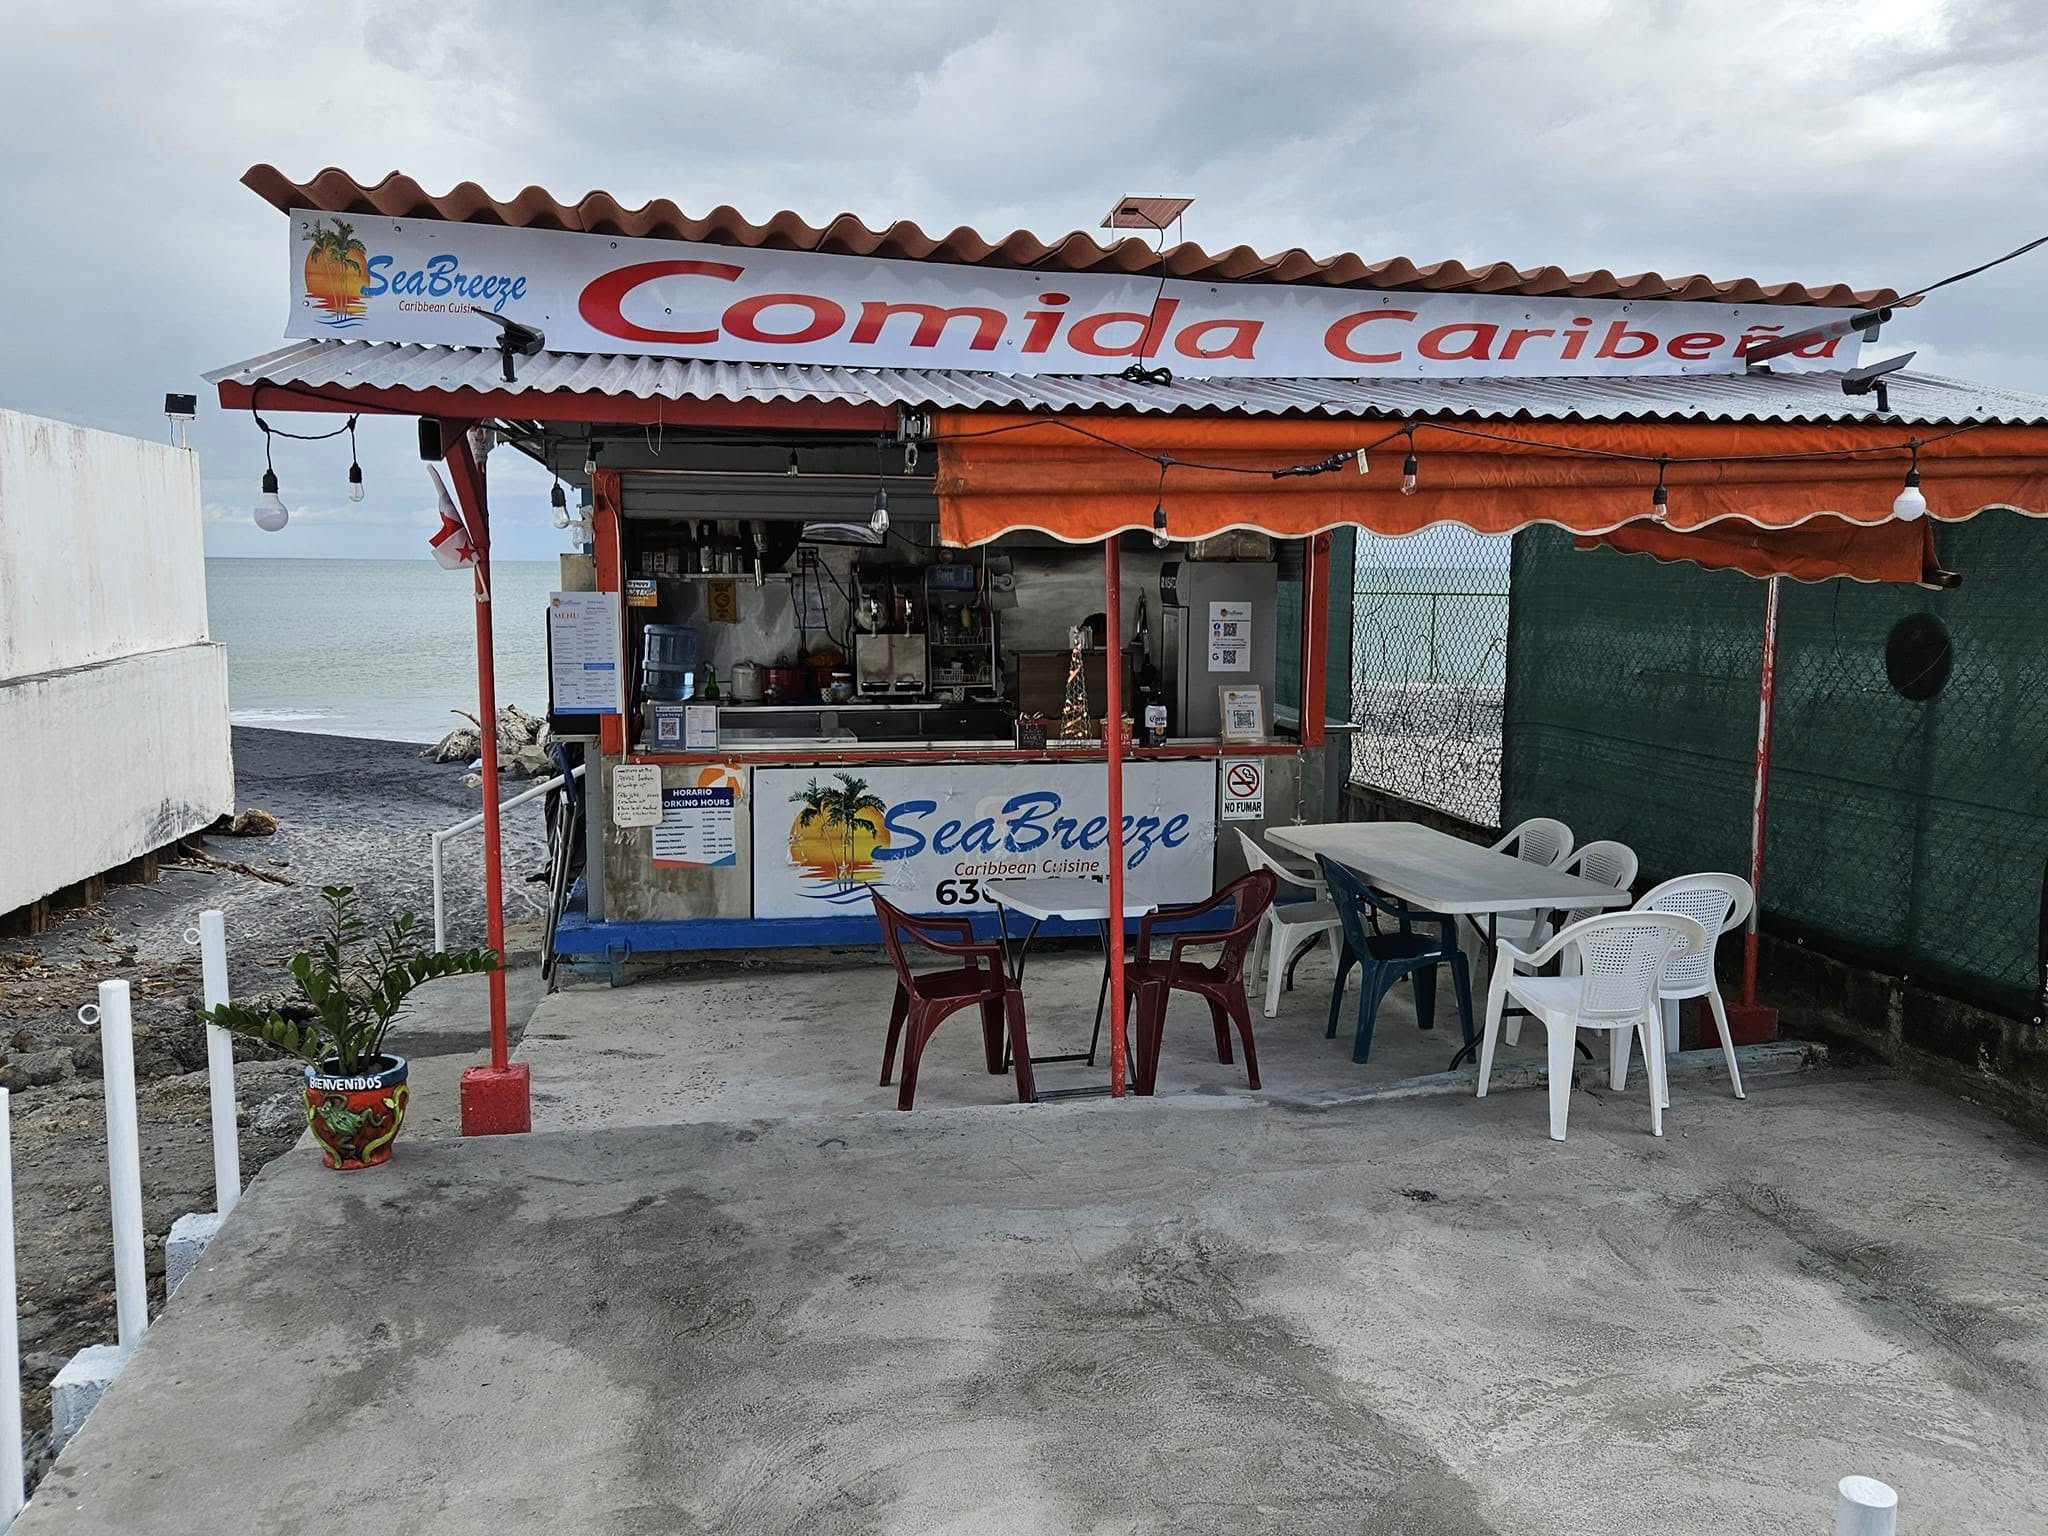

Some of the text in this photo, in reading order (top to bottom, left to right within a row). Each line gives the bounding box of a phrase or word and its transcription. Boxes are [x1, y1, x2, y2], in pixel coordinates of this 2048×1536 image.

[360, 254, 527, 314] SeaBreeze
[398, 300, 446, 313] Caribbean
[578, 258, 1265, 361] Comida
[663, 800, 699, 808] ORKING
[1224, 801, 1262, 813] NO FUMAR
[870, 791, 1190, 870] SeaBreeze
[954, 862, 1037, 876] Caribbean
